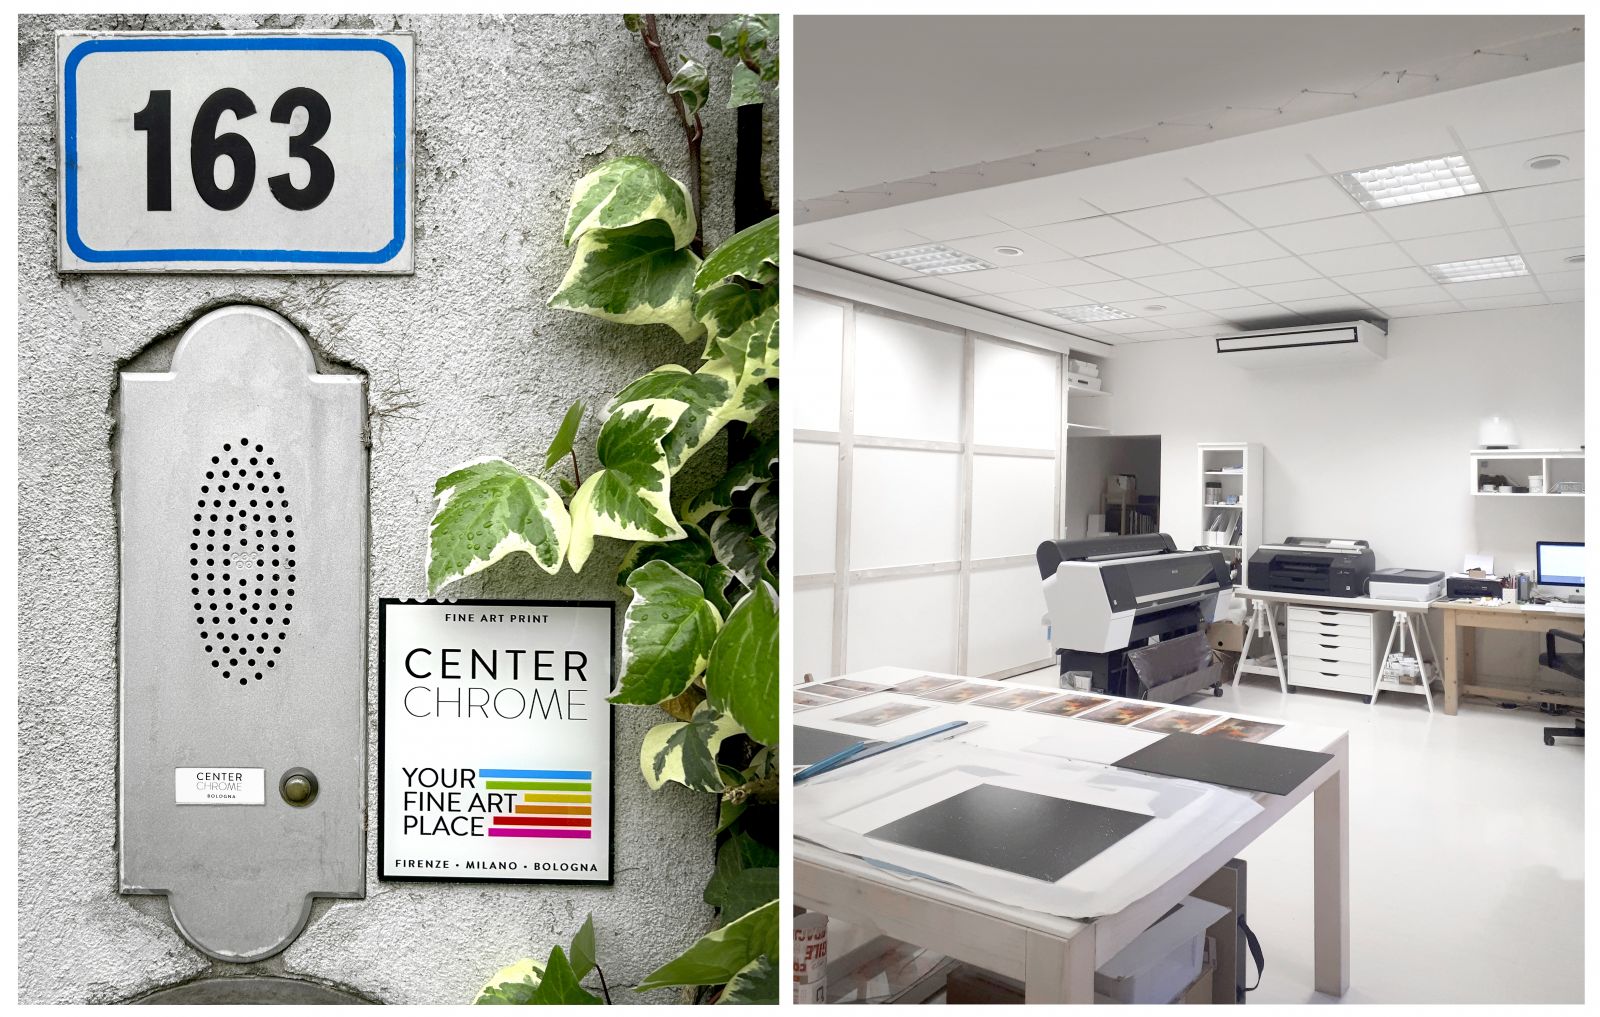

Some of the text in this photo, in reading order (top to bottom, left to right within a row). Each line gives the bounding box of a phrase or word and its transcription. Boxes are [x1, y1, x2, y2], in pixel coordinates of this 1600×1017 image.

[133, 86, 335, 211] 163
[445, 613, 549, 624] FINE ART PRINT
[405, 647, 588, 682] CENTER
[404, 686, 588, 721] CHROME
[196, 772, 243, 781] CENTER
[196, 781, 243, 792] CHROME
[402, 767, 476, 789] YOUR
[404, 791, 517, 814] FINE ART
[404, 815, 485, 837] PLACE
[395, 859, 598, 872] FIRENZE MILANO BOLOGNA
